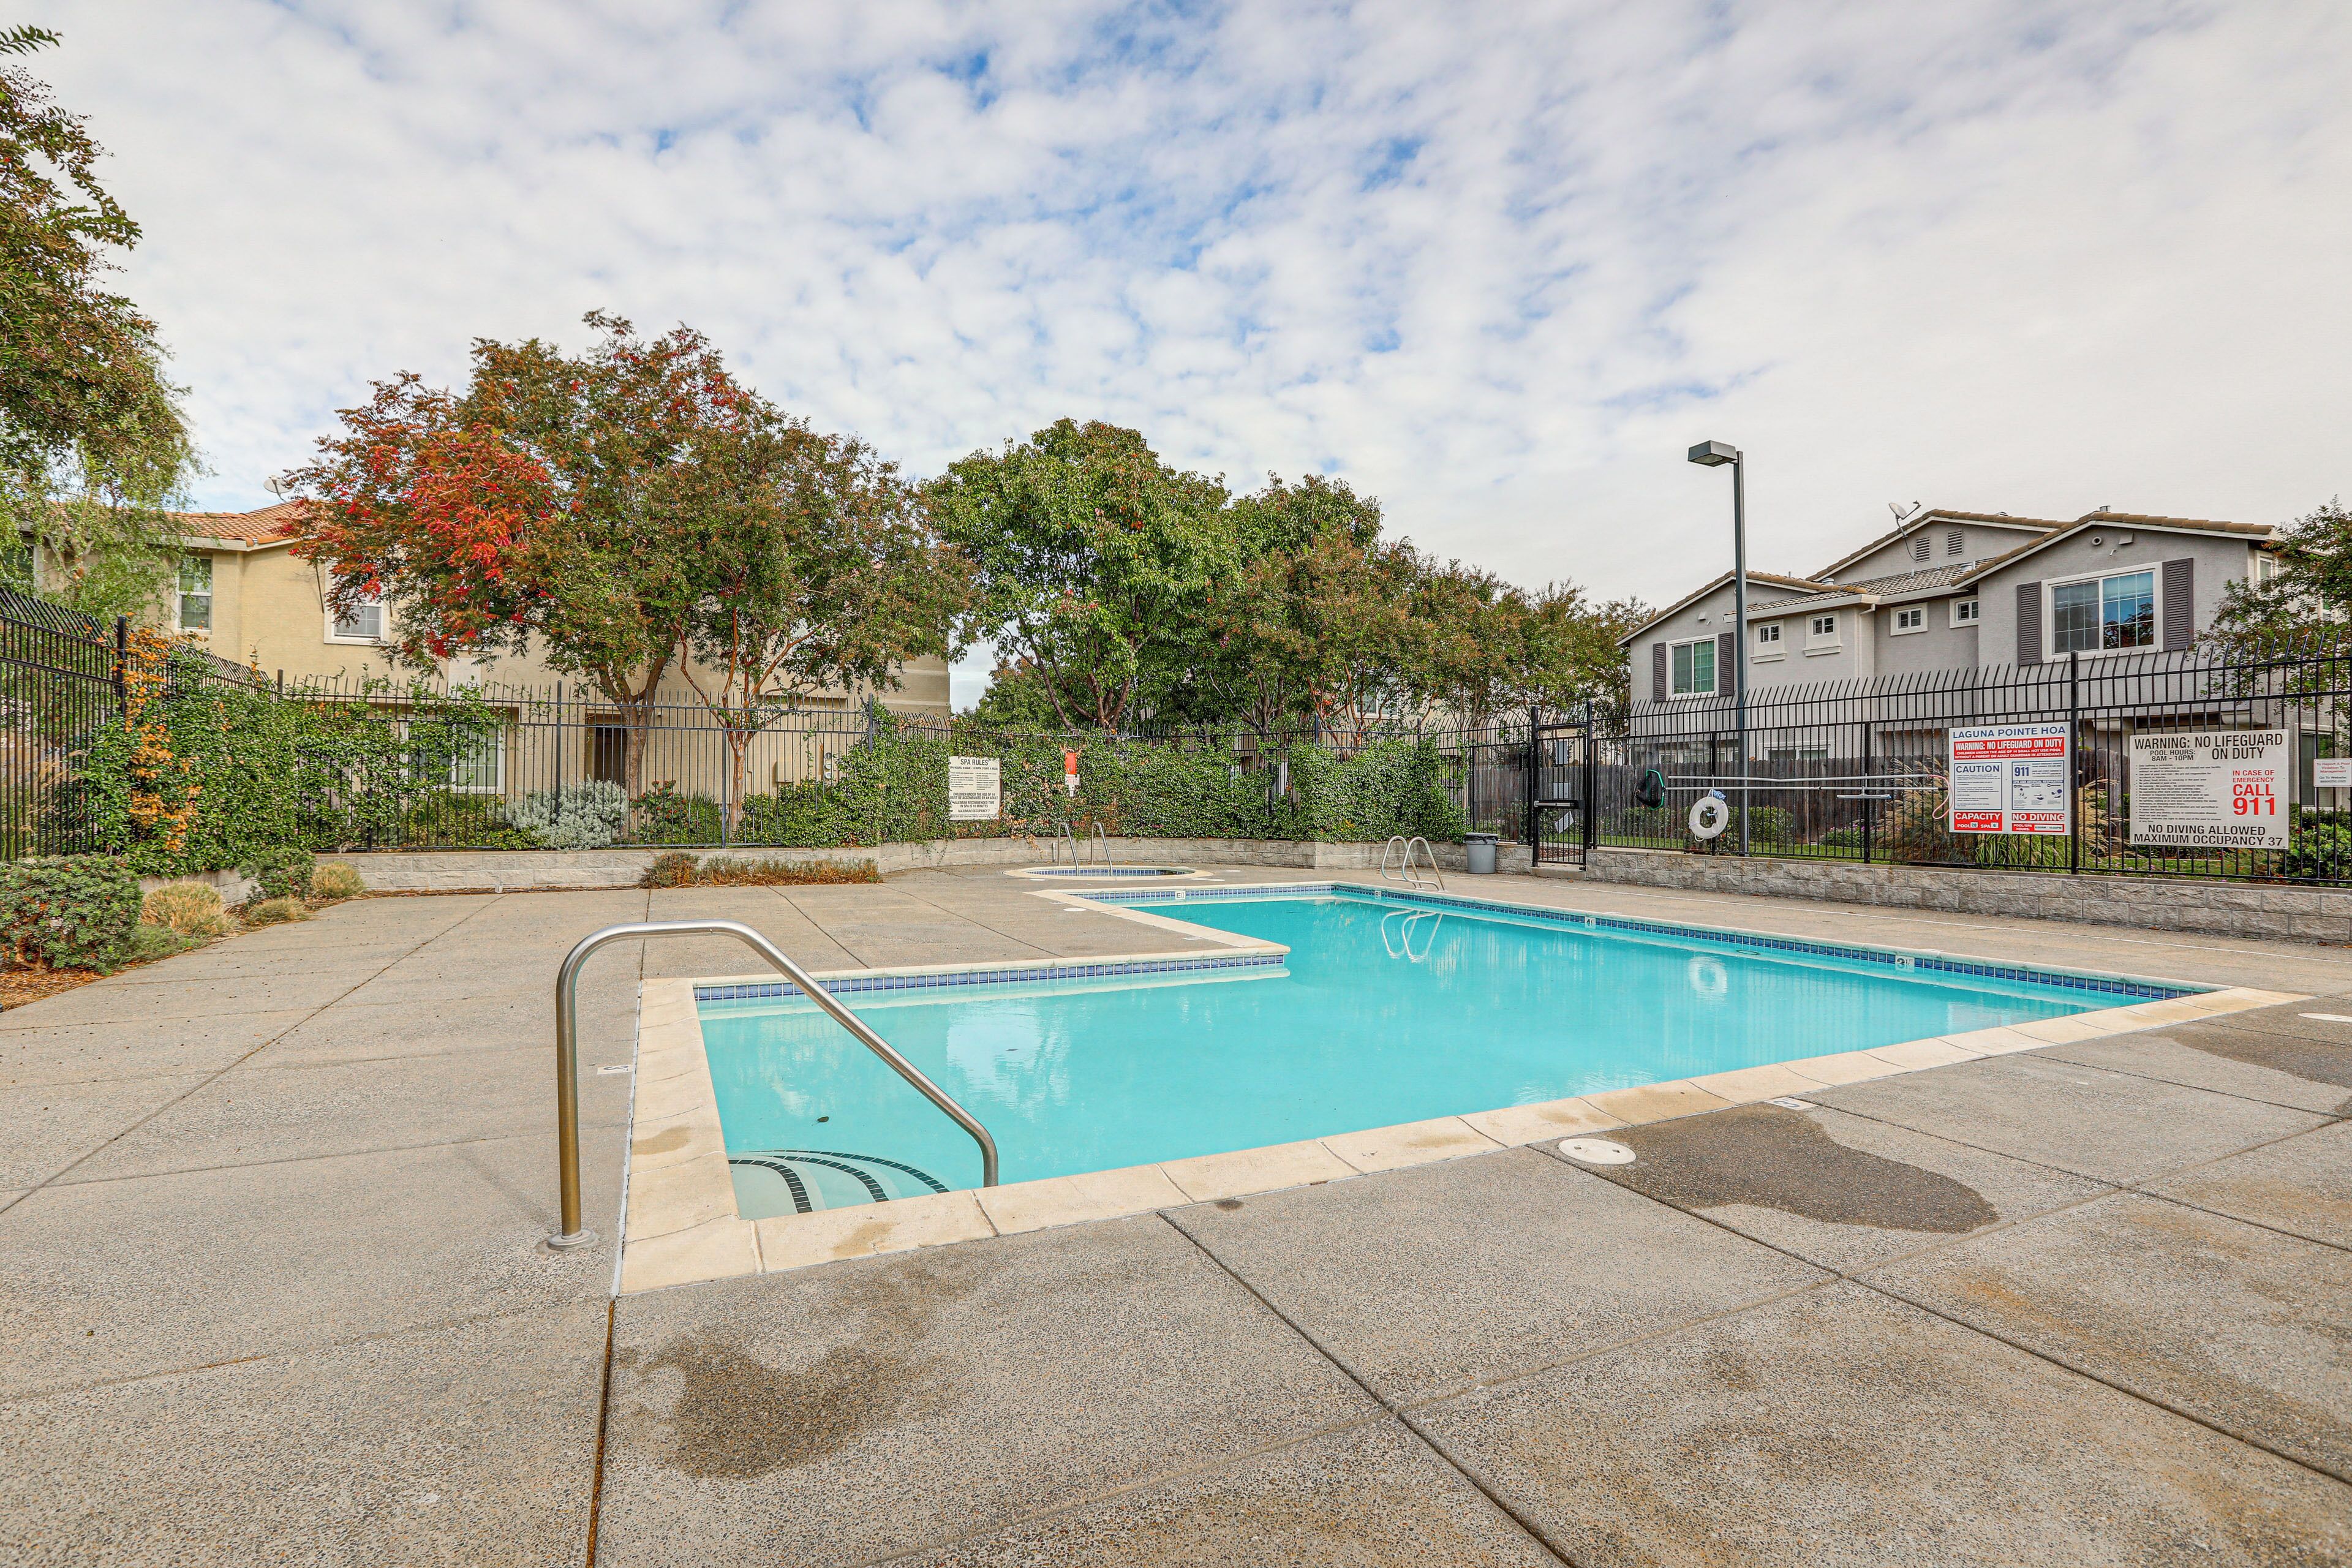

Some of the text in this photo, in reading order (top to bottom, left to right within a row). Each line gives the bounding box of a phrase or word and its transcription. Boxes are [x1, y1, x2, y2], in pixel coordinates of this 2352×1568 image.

[1953, 726, 2065, 739] LAGUNA POINTE HOA
[1955, 738, 2063, 751] WARNING: NO LIFEGUARD ON DUTY
[2135, 733, 2283, 750] WARNING: NO LIFEGUARD
[2212, 747, 2264, 760] ON DUTY
[2014, 767, 2029, 777] 911
[2233, 784, 2274, 796] CALL
[2233, 797, 2275, 815] 911
[2148, 824, 2266, 835] NO DIVING ALLOWED
[2134, 834, 2283, 846] MAXIMUM OCCUPANCY 37
